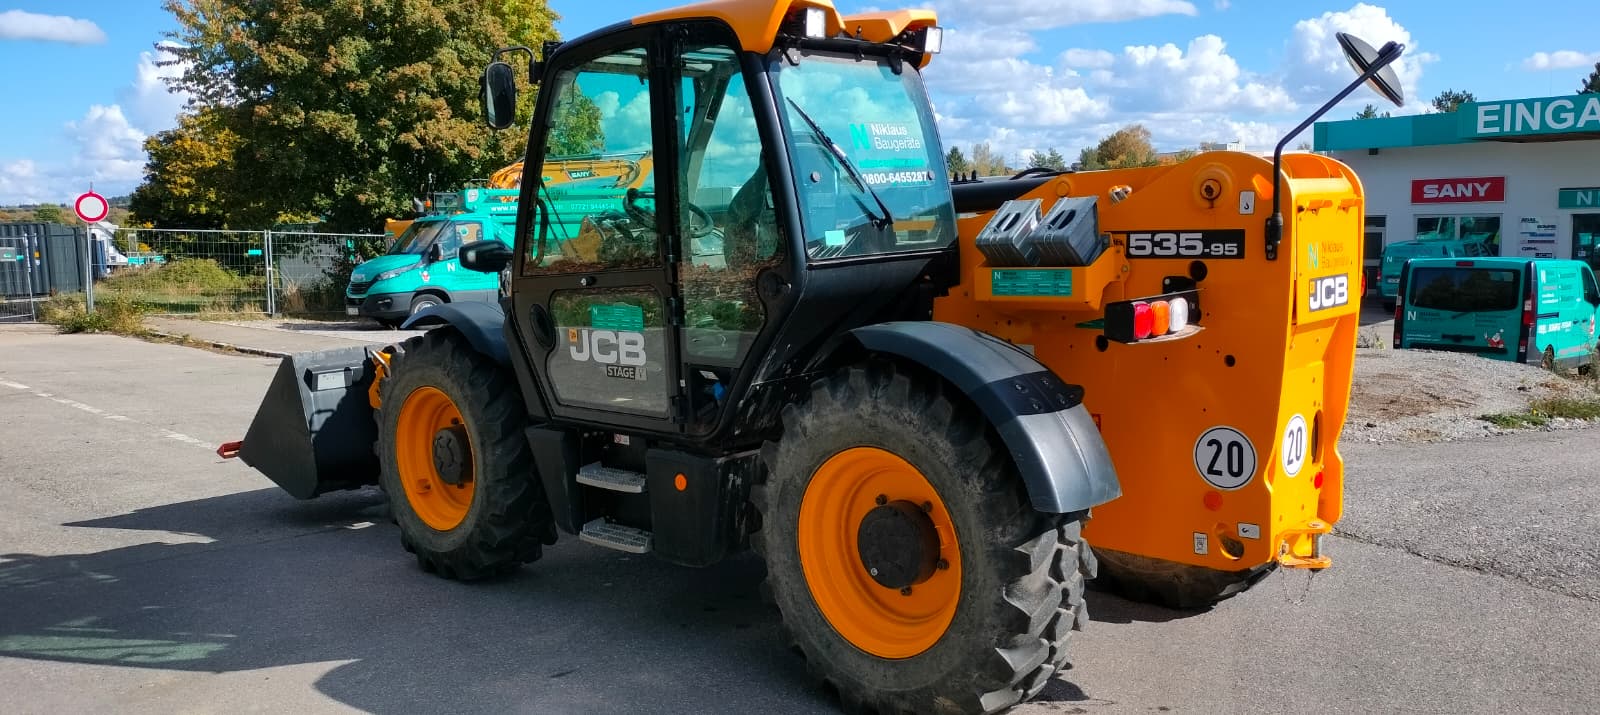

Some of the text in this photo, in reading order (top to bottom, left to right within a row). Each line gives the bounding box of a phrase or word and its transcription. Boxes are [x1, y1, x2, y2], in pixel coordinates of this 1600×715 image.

[870, 123, 908, 136] Niklaus
[1477, 97, 1600, 134] EINGA
[874, 136, 921, 152] Baugeräte
[1423, 182, 1492, 199] SANY
[1129, 232, 1238, 256] 535-95
[1309, 276, 1348, 310] JCB
[569, 329, 647, 367] JCB
[607, 366, 635, 380] STAGE
[1207, 438, 1243, 477] 20
[1288, 427, 1303, 465] 20
